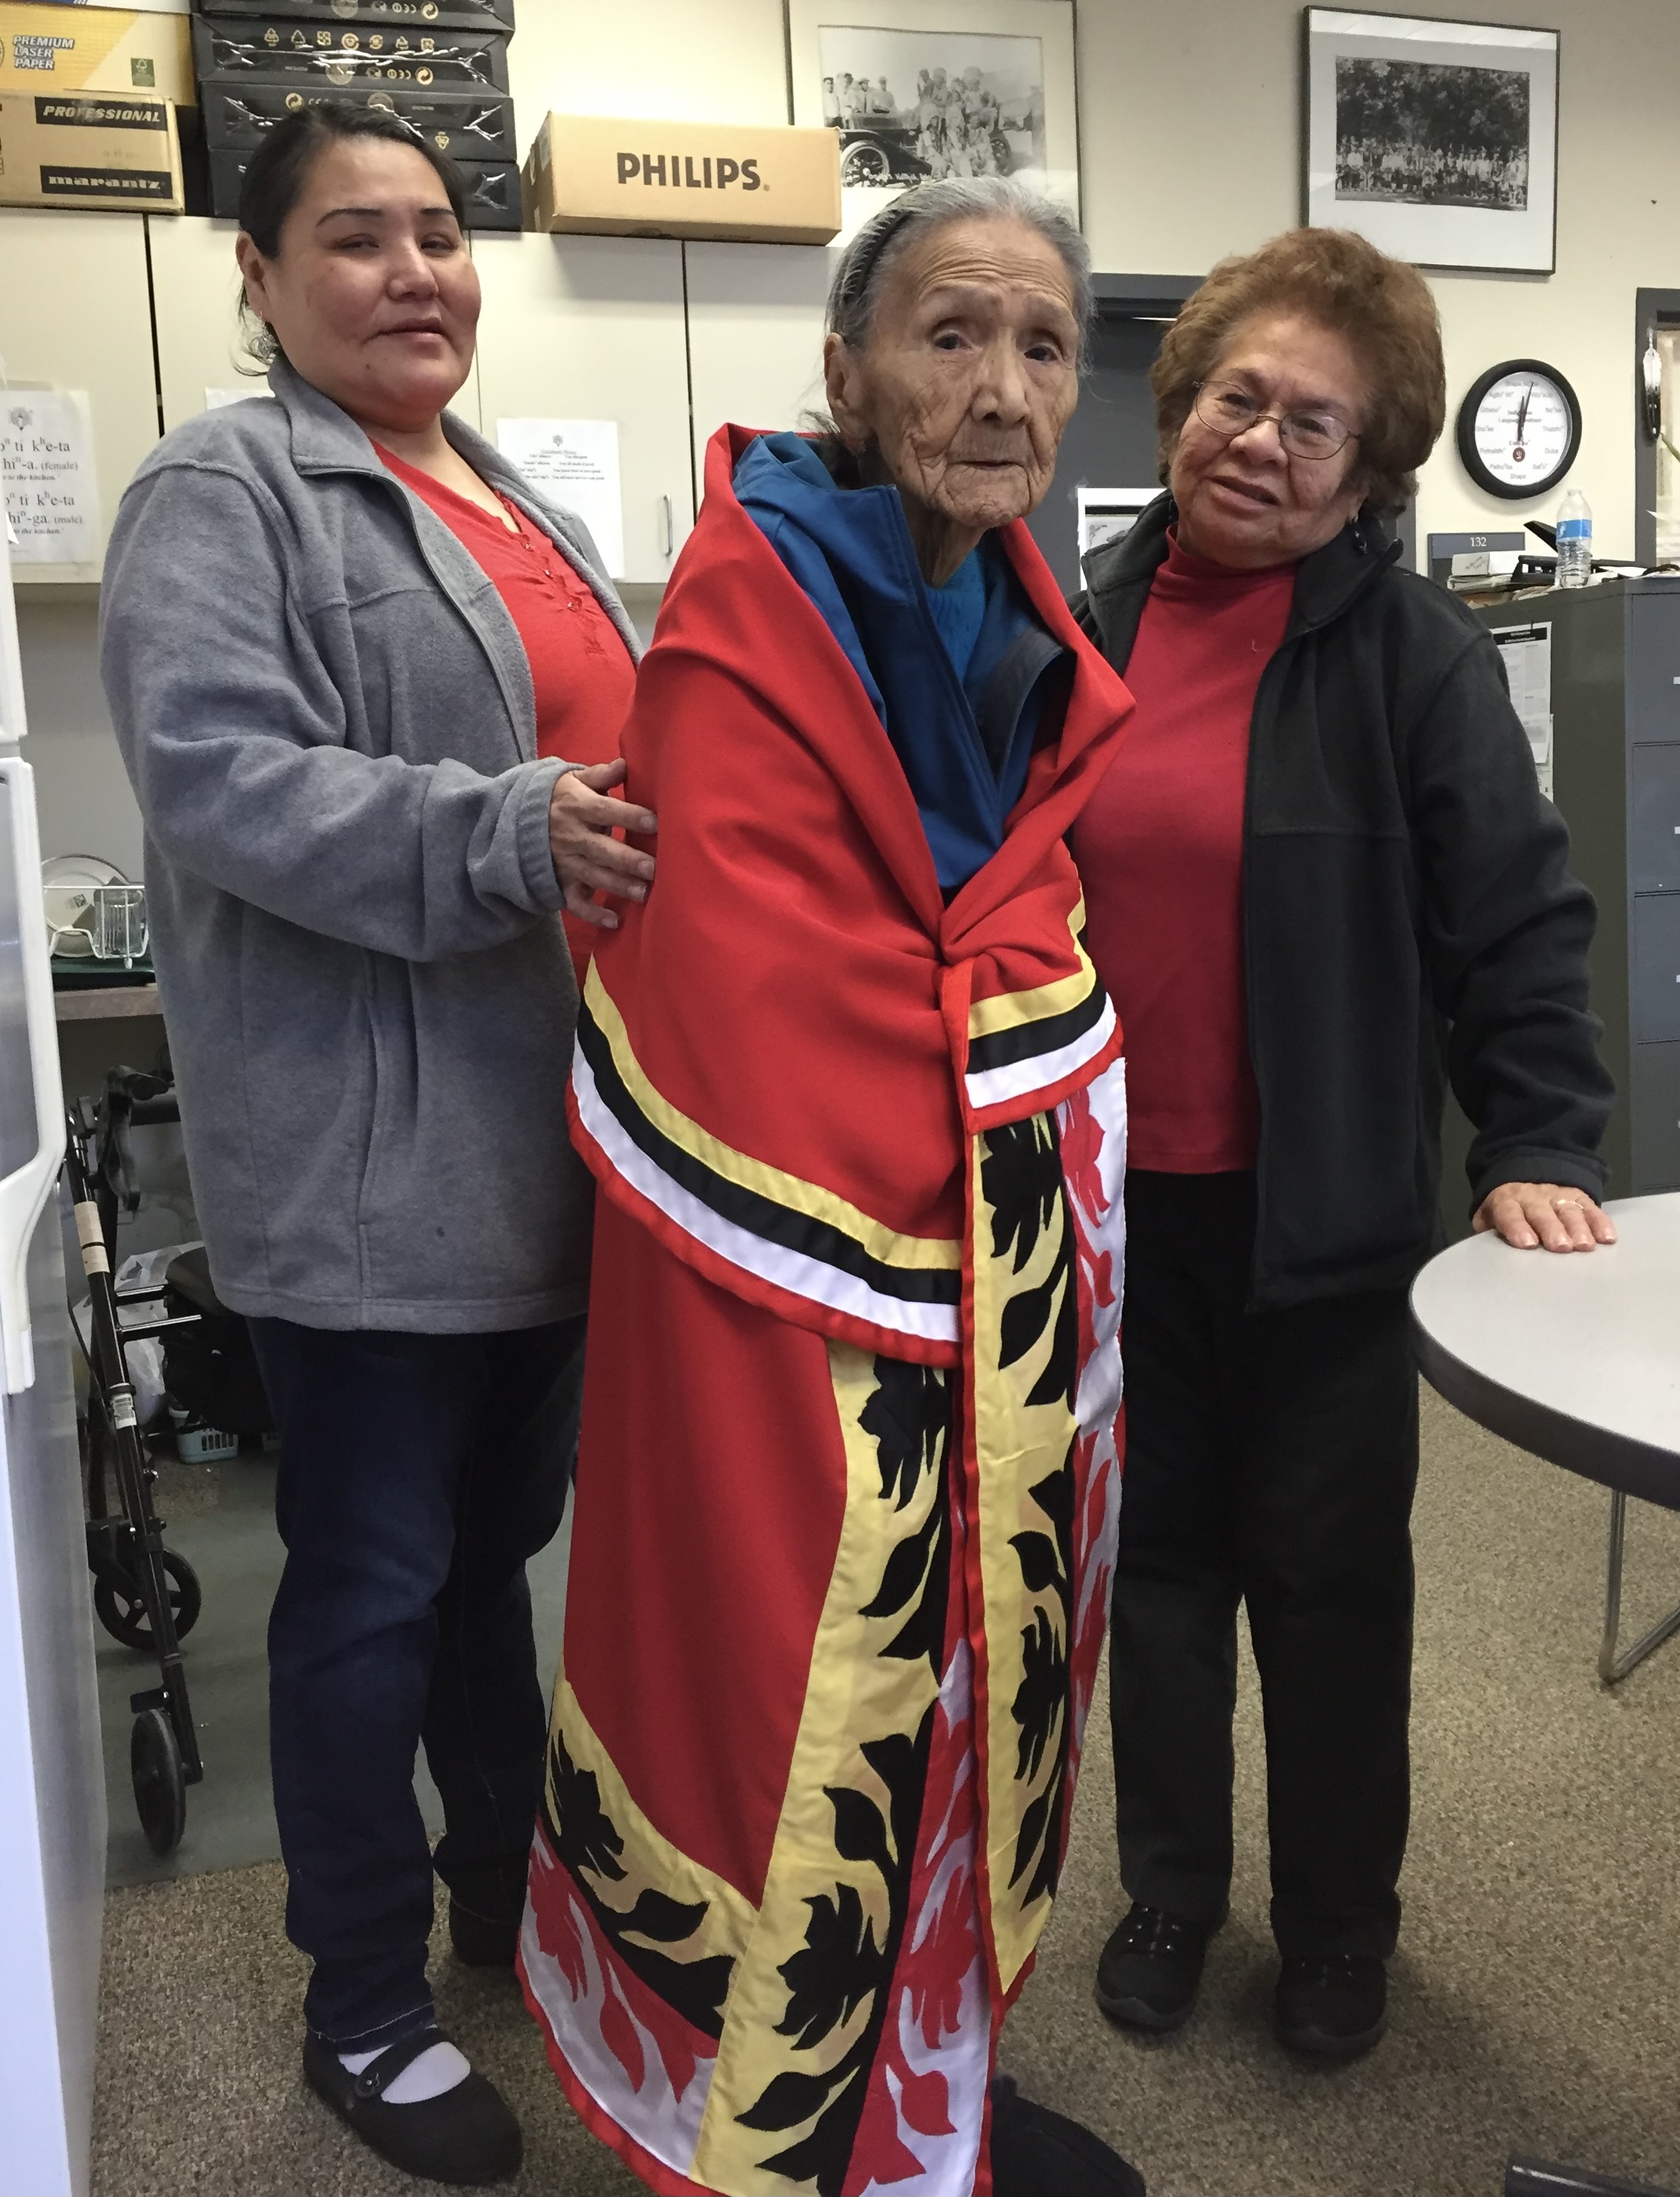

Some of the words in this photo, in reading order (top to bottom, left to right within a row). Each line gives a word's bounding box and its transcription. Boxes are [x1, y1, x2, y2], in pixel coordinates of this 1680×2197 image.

[13, 35, 74, 50] PREMIUM
[14, 46, 53, 59] LASER
[15, 57, 54, 70] PAPER
[43, 105, 160, 122] PROFESSIONAL
[617, 152, 761, 191] PHILIPS
[48, 176, 160, 189] marantz
[15, 439, 23, 452] ti
[41, 461, 78, 470] (female)
[20, 493, 28, 505] ti
[54, 515, 83, 524] (male)
[1470, 536, 1486, 547] 132
